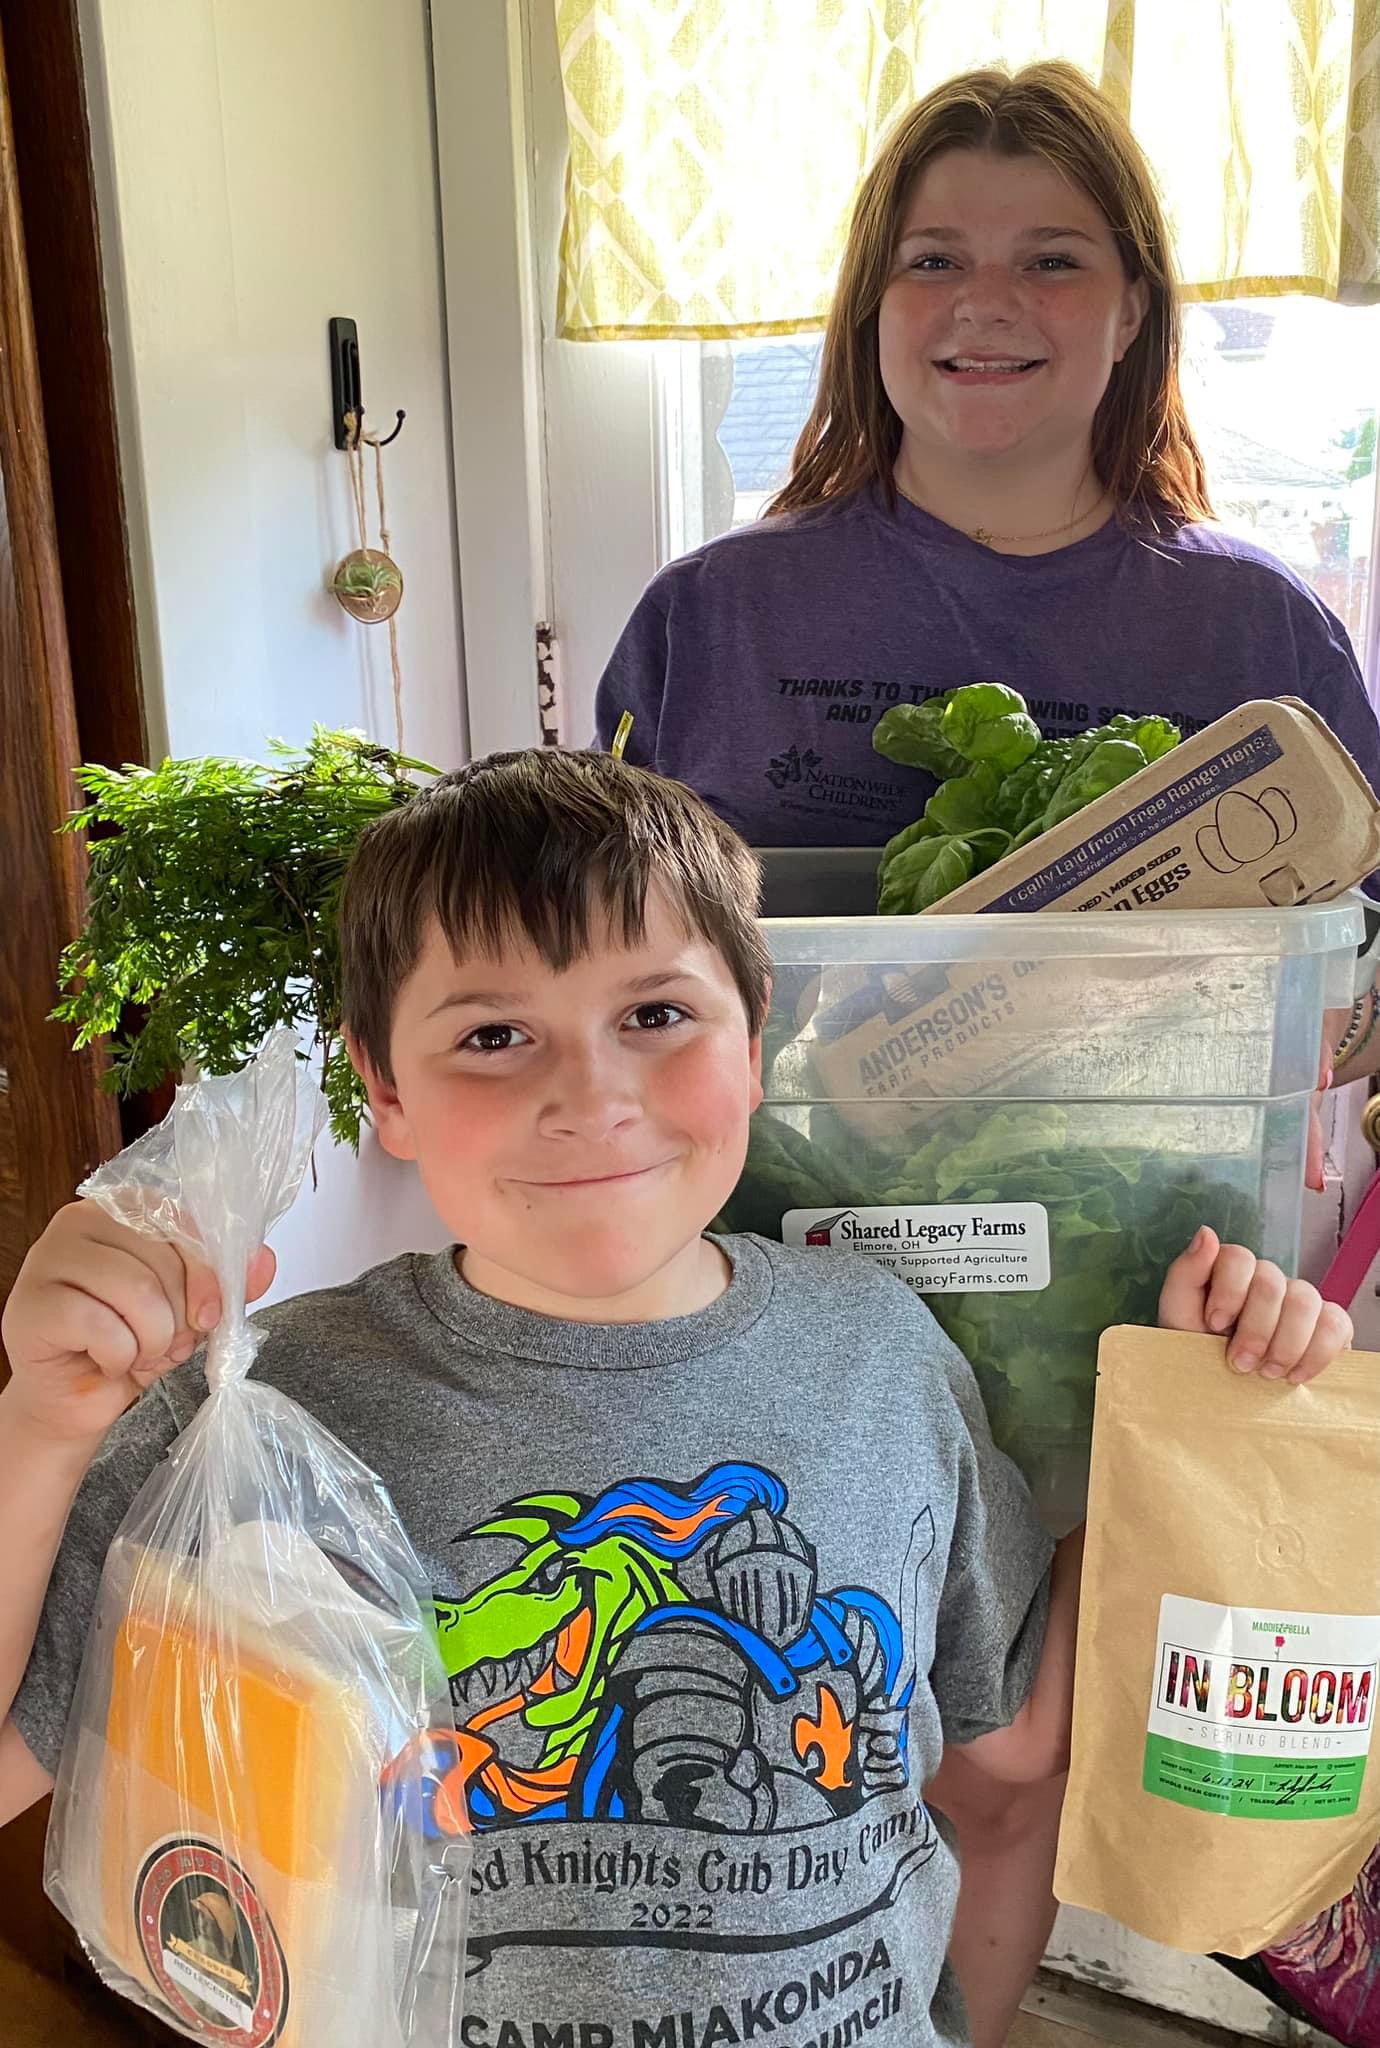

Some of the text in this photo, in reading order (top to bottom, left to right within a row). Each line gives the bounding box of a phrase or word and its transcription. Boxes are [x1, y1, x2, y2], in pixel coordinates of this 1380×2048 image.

[778, 678, 864, 698] THANKS
[872, 681, 901, 701] TO
[910, 684, 946, 704] TH
[825, 703, 872, 724] AND
[1055, 847, 1088, 876] Laid
[1087, 823, 1129, 855] from
[1128, 798, 1167, 828] Free
[1167, 764, 1221, 804] Range
[1220, 736, 1266, 769] Hens
[1109, 866, 1146, 895] MIXED
[1146, 846, 1181, 871] SIZED
[1131, 862, 1191, 905] Eggs
[858, 973, 1008, 1085] ANDERSON'S
[920, 1000, 1016, 1068] PRODUCTS
[841, 1217, 1026, 1243] Shared Legacy Farms
[853, 1240, 920, 1251] Elmore, OH
[901, 1255, 960, 1267] Supported
[964, 1254, 1028, 1266] Agriculture
[1166, 1651, 1371, 1724] IN BLOOM
[522, 1838, 682, 1894] Knights
[699, 1847, 772, 1895] Cub
[787, 1844, 848, 1887] Day
[630, 1902, 714, 1929] 2022
[460, 1938, 892, 2048] CAMP MIAKONDA
